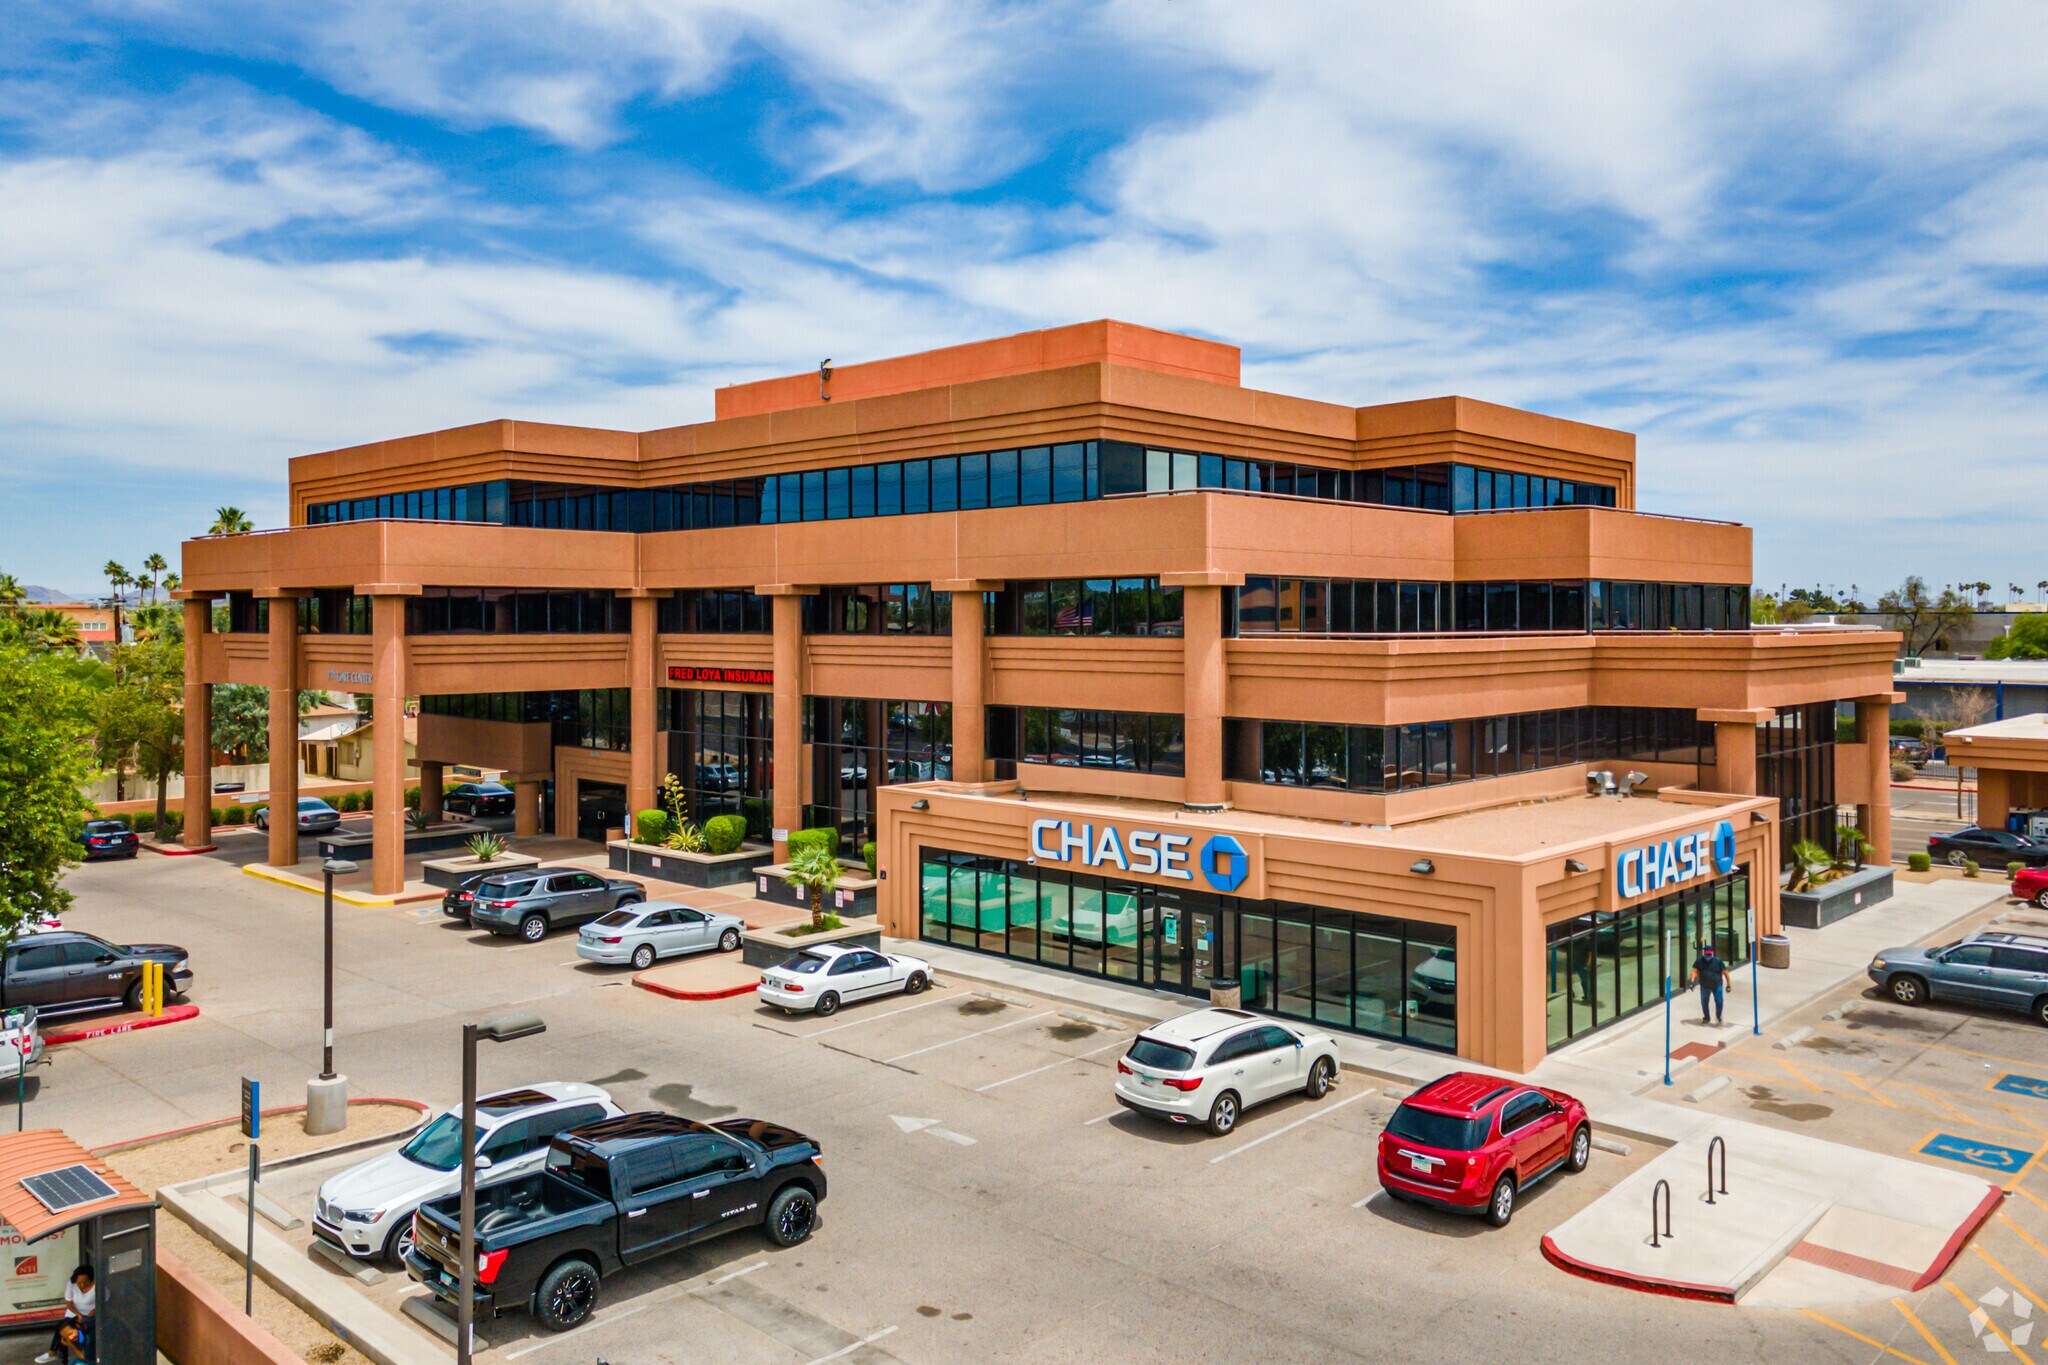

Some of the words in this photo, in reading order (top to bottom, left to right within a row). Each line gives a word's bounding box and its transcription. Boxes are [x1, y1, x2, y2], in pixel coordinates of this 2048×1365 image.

[351, 672, 373, 684] CENTER
[669, 667, 694, 680] FRED
[695, 667, 721, 681] LOYA
[1032, 818, 1193, 880] CHASE
[1617, 831, 1711, 898] CHASE
[86, 1029, 105, 1039] FIRE
[111, 1025, 133, 1035] LANE
[720, 1206, 745, 1218] TITAN
[0, 1230, 66, 1246] MOS?
[20, 1265, 36, 1274] NTI
